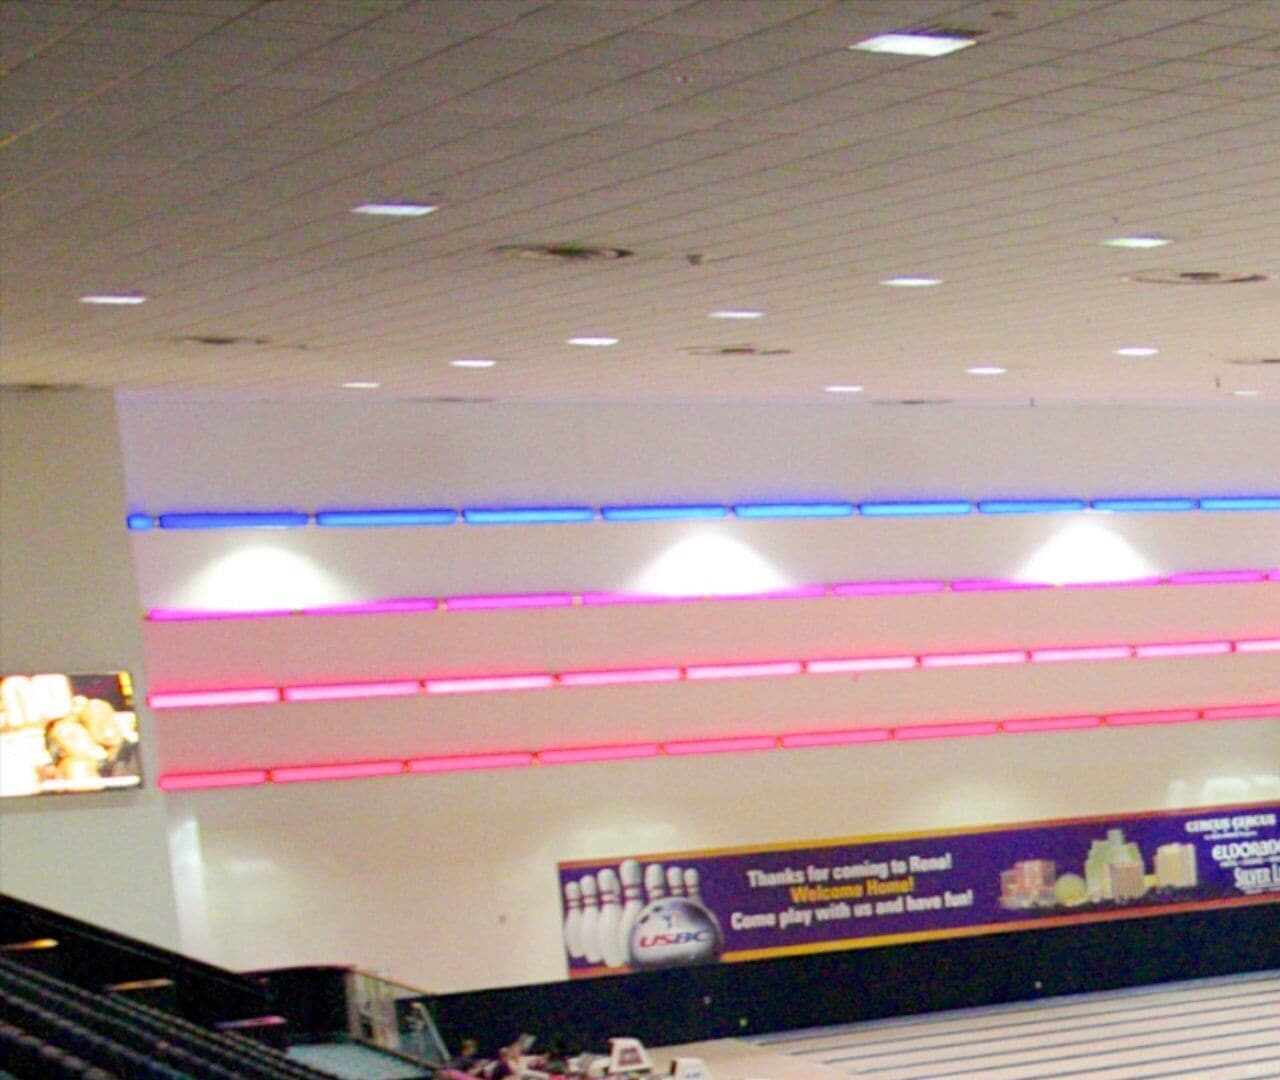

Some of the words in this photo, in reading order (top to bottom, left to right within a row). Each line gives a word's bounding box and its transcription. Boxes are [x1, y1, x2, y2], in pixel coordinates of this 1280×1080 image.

[747, 867, 805, 888] Thanks
[807, 865, 830, 882] for
[832, 860, 889, 880] coming
[890, 859, 908, 874] to
[909, 852, 953, 873] Reno!
[789, 884, 863, 903] Welcome
[731, 911, 776, 930] Come
[778, 908, 813, 929] play
[815, 902, 851, 921] with
[853, 903, 873, 917] us
[875, 896, 904, 915] and
[905, 895, 942, 911] have
[639, 932, 707, 948] USBC
